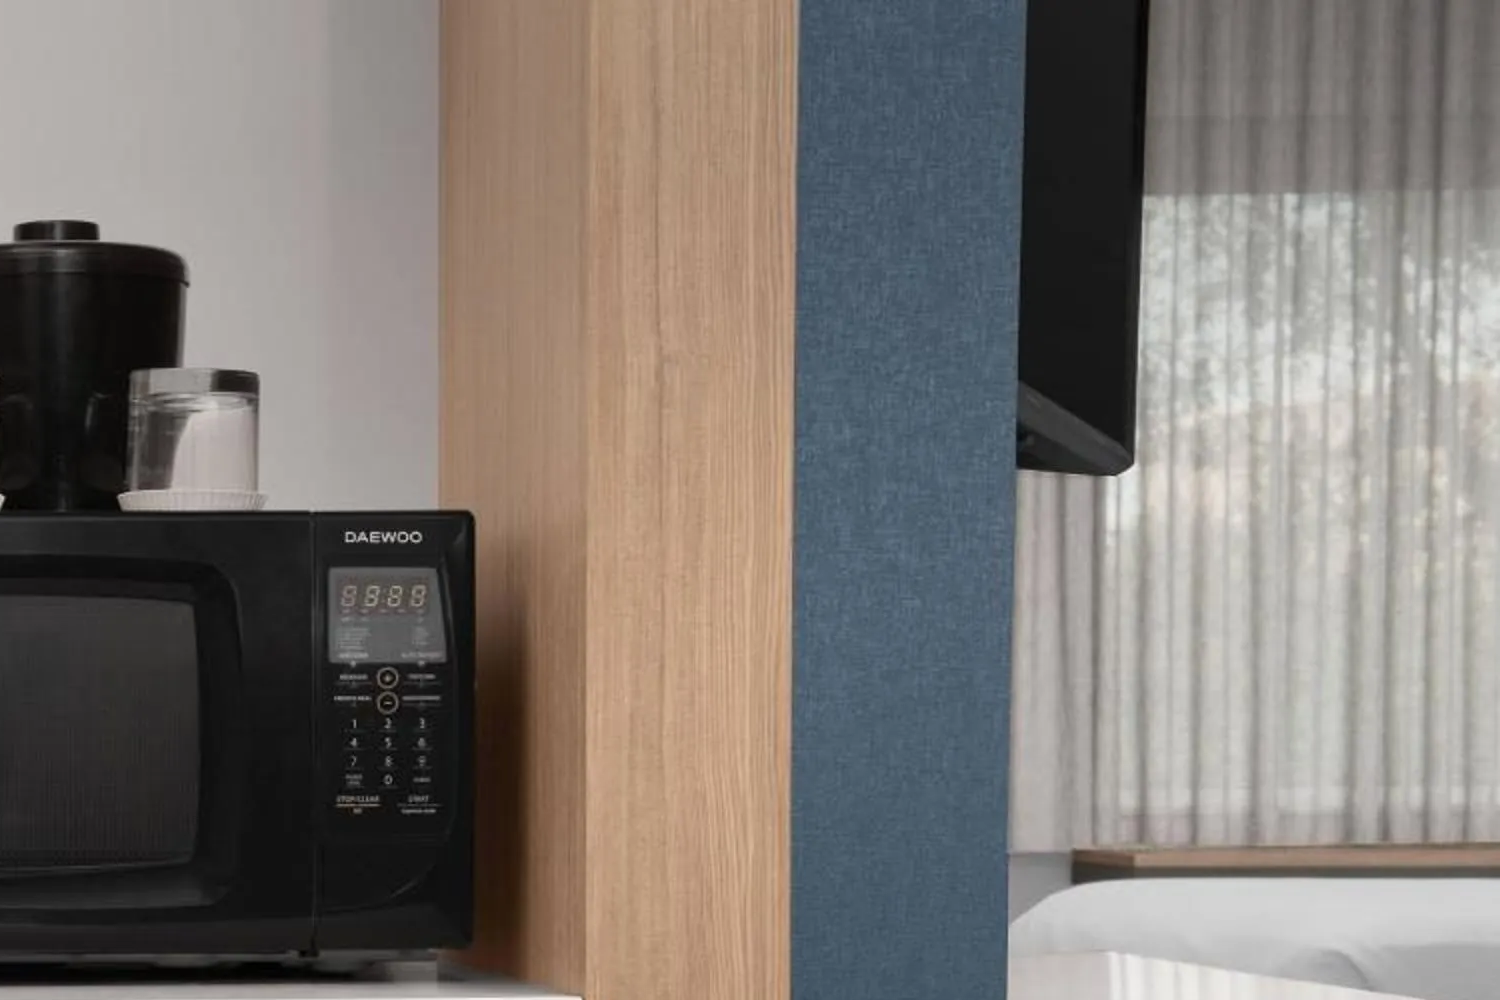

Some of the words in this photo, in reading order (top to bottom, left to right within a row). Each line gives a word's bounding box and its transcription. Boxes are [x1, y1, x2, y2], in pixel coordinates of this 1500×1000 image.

[344, 531, 423, 544] DAEWOO
[383, 717, 393, 730] 2
[383, 773, 394, 785] 0
